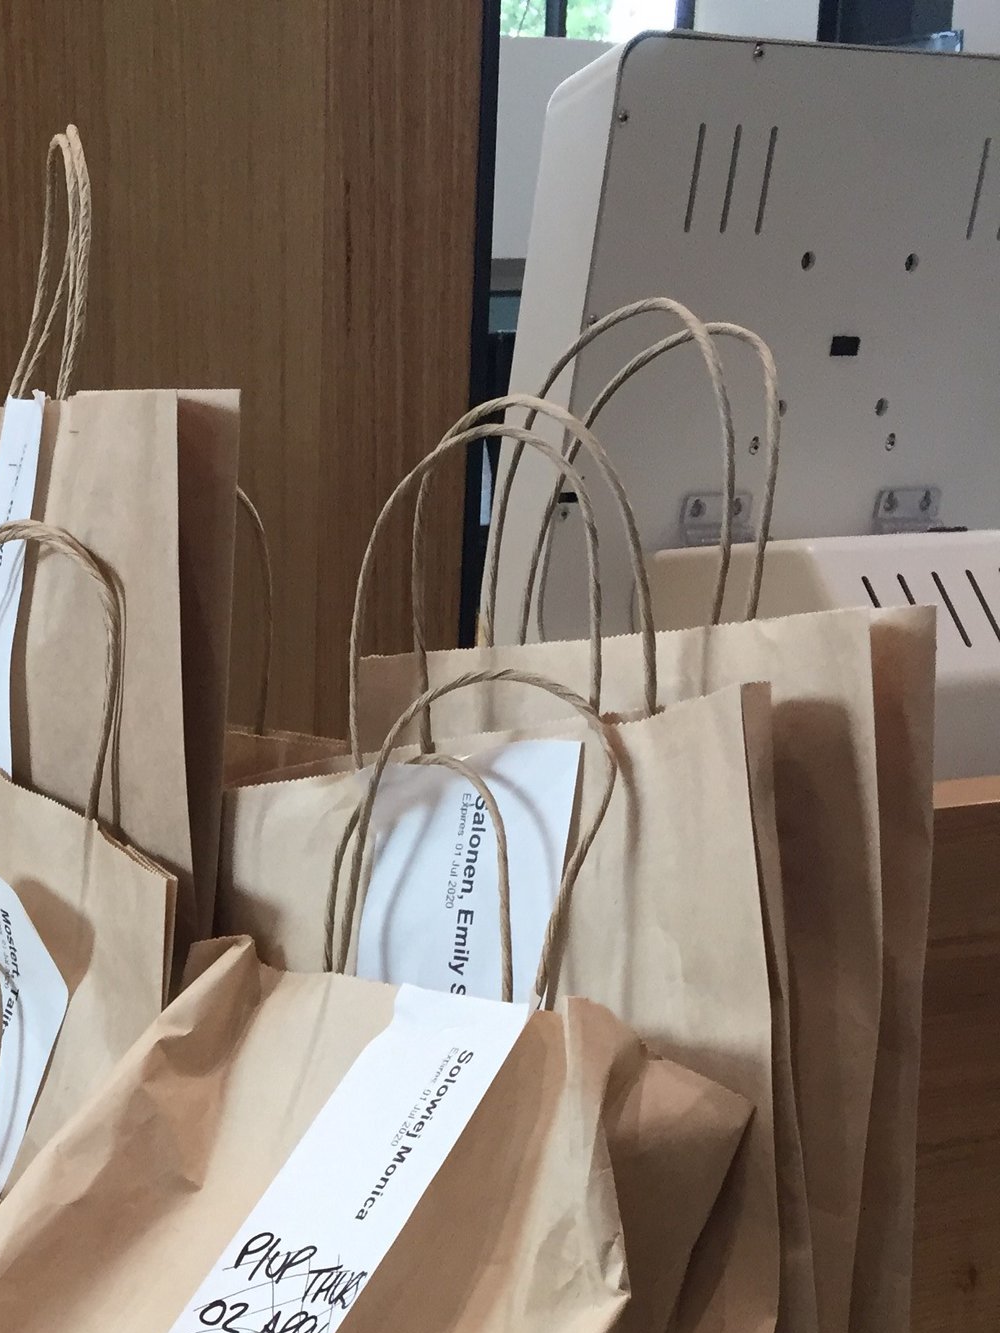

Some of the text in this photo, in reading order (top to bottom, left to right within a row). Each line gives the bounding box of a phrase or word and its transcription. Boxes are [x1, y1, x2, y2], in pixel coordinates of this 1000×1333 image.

[449, 861, 460, 877] Jul
[445, 881, 457, 909] 2020
[448, 909, 474, 976] Emily
[355, 1049, 474, 1221] Solowiej Monica
[391, 1121, 411, 1147] 2020
